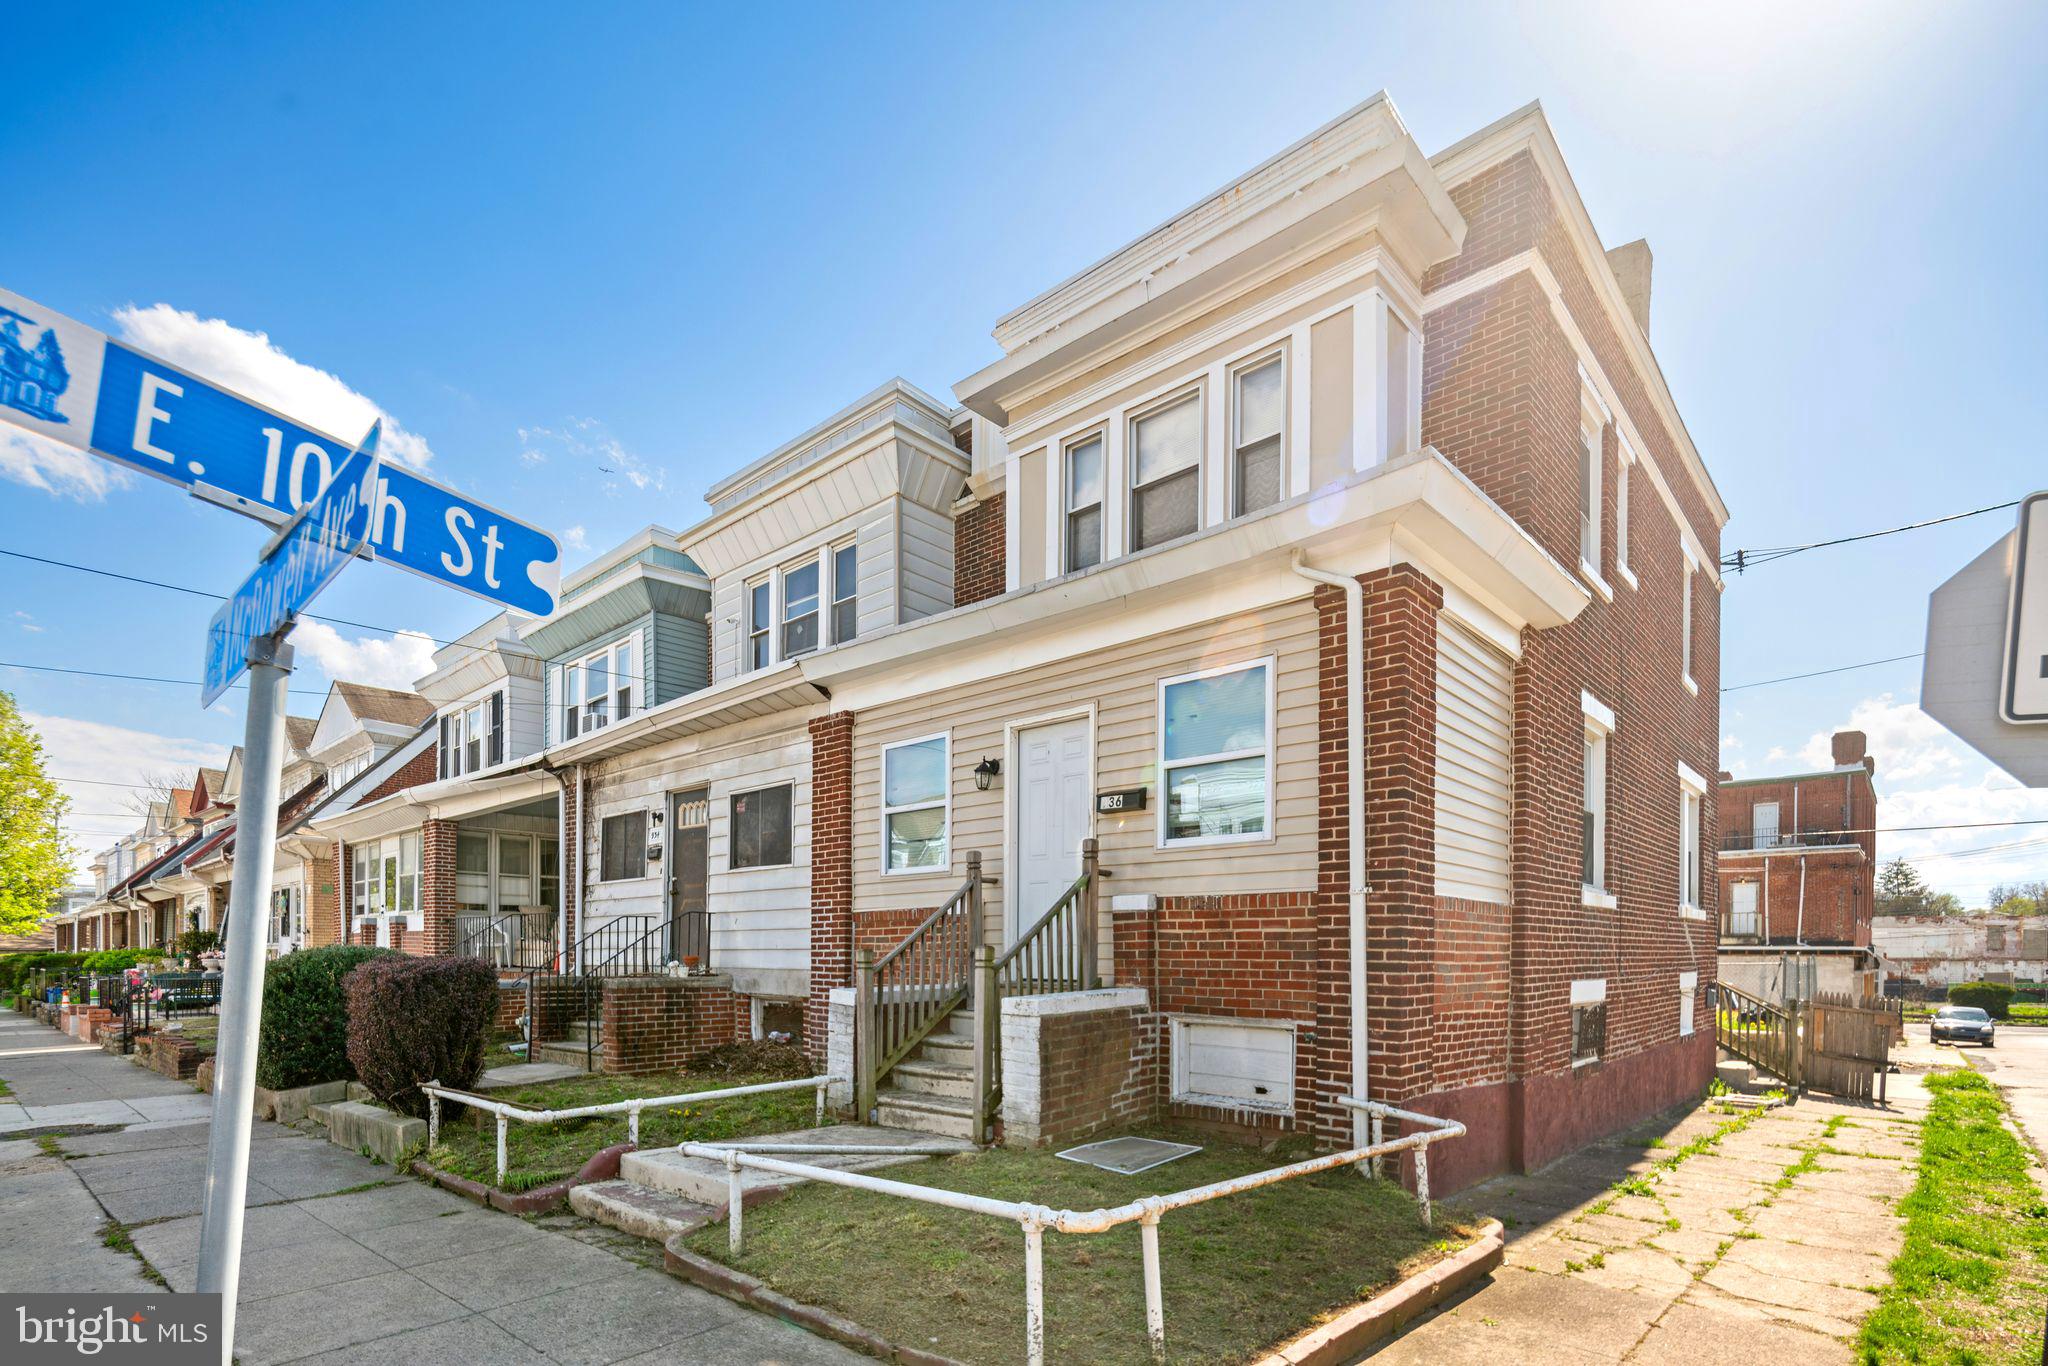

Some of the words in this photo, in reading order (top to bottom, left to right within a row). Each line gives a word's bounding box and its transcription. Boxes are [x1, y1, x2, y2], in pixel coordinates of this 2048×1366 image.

[132, 371, 205, 475] E.
[261, 427, 406, 552] 10h
[440, 506, 505, 589] St
[312, 483, 357, 584] Ave
[1108, 796, 1122, 808] 36
